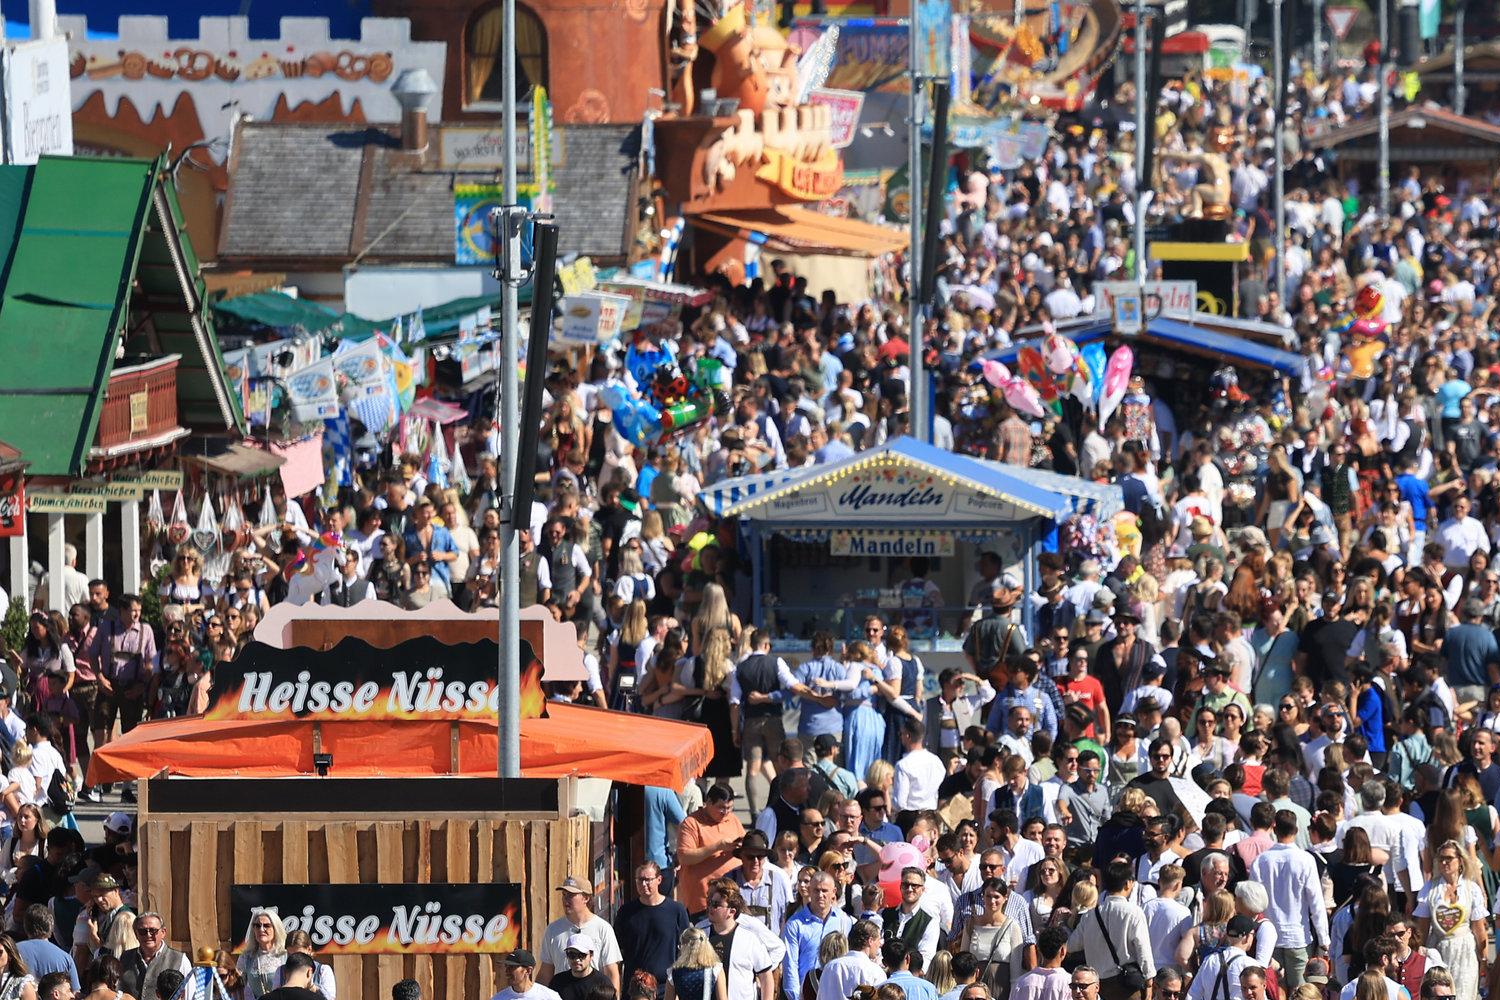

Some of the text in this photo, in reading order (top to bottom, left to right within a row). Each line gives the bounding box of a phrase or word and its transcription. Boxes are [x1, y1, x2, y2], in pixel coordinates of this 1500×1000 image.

[33, 497, 65, 507] Blumen
[838, 484, 944, 510] Mandeln
[850, 536, 936, 555] Mandeln
[237, 670, 380, 713] Heisse
[386, 901, 509, 945] Nüsse
